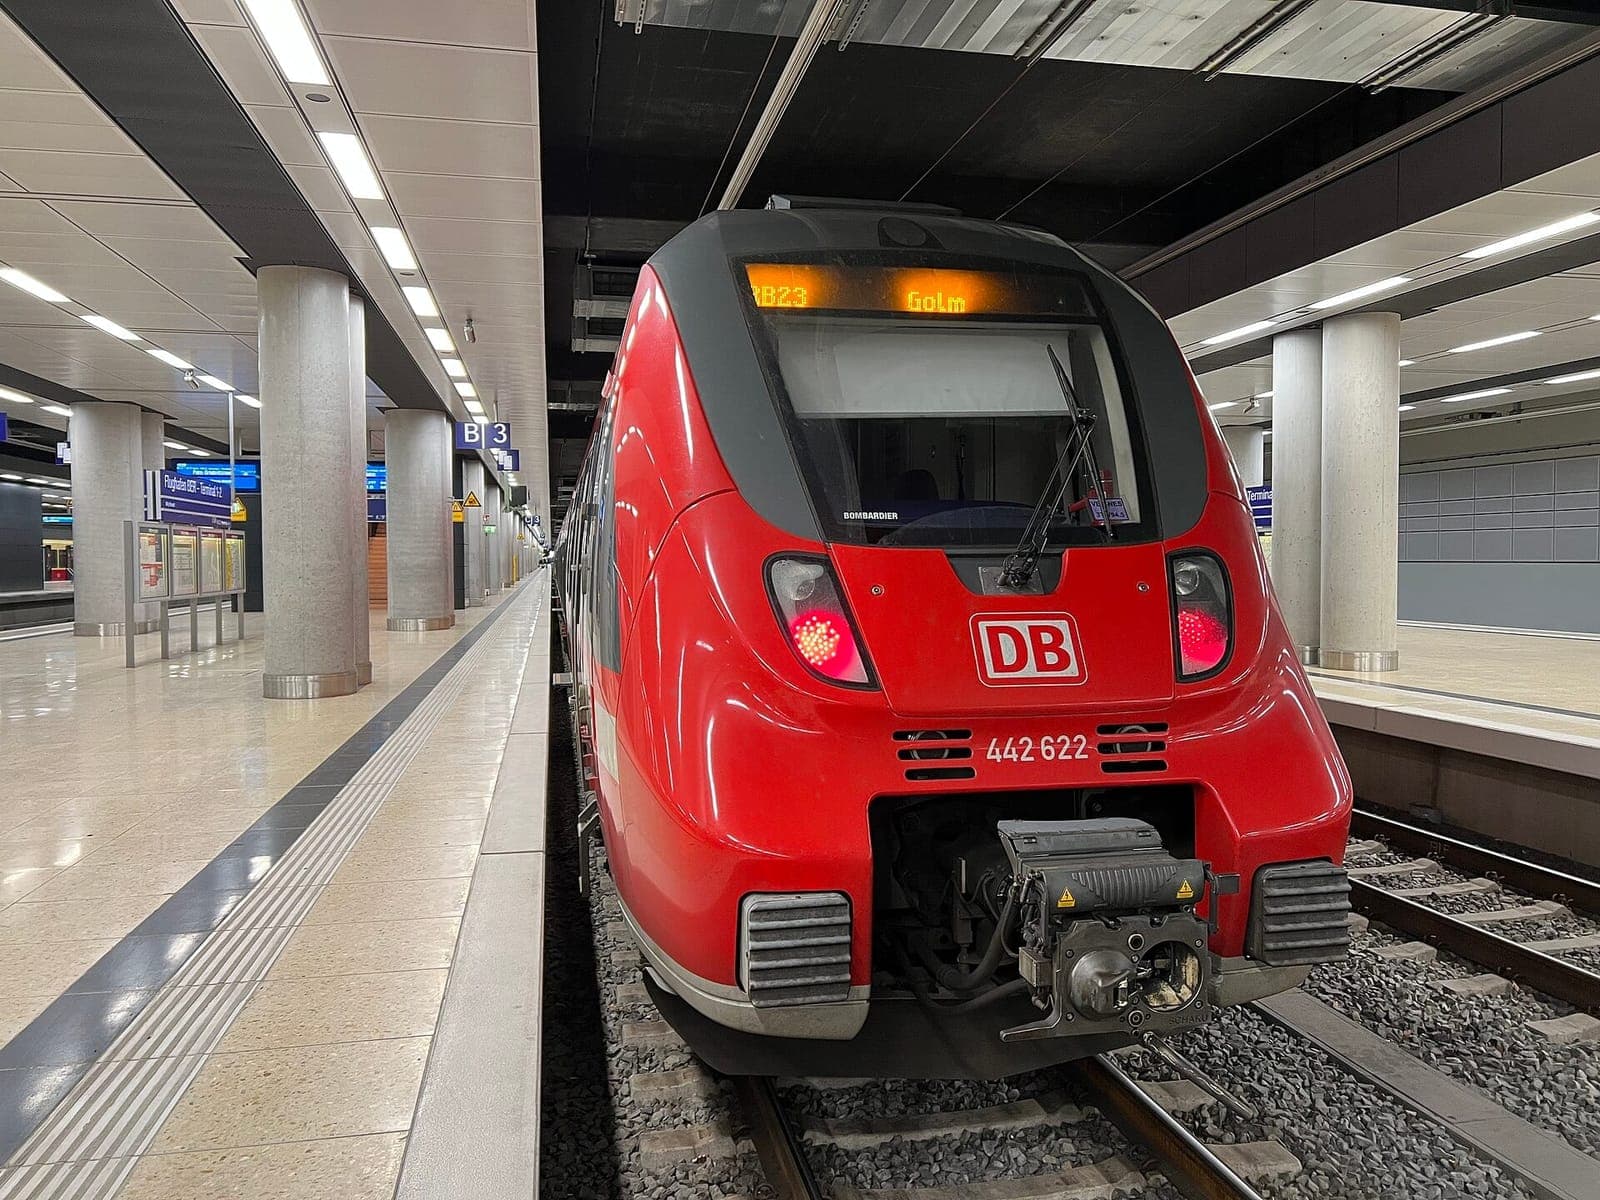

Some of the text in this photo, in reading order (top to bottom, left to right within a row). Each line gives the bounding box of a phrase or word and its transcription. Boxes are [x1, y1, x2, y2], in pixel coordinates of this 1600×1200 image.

[908, 291, 965, 313] Golm
[464, 423, 507, 444] B 3
[1247, 489, 1273, 502] Termina
[843, 511, 898, 520] BOMBARDIER
[985, 624, 1072, 674] DB
[986, 734, 1089, 763] 442 622
